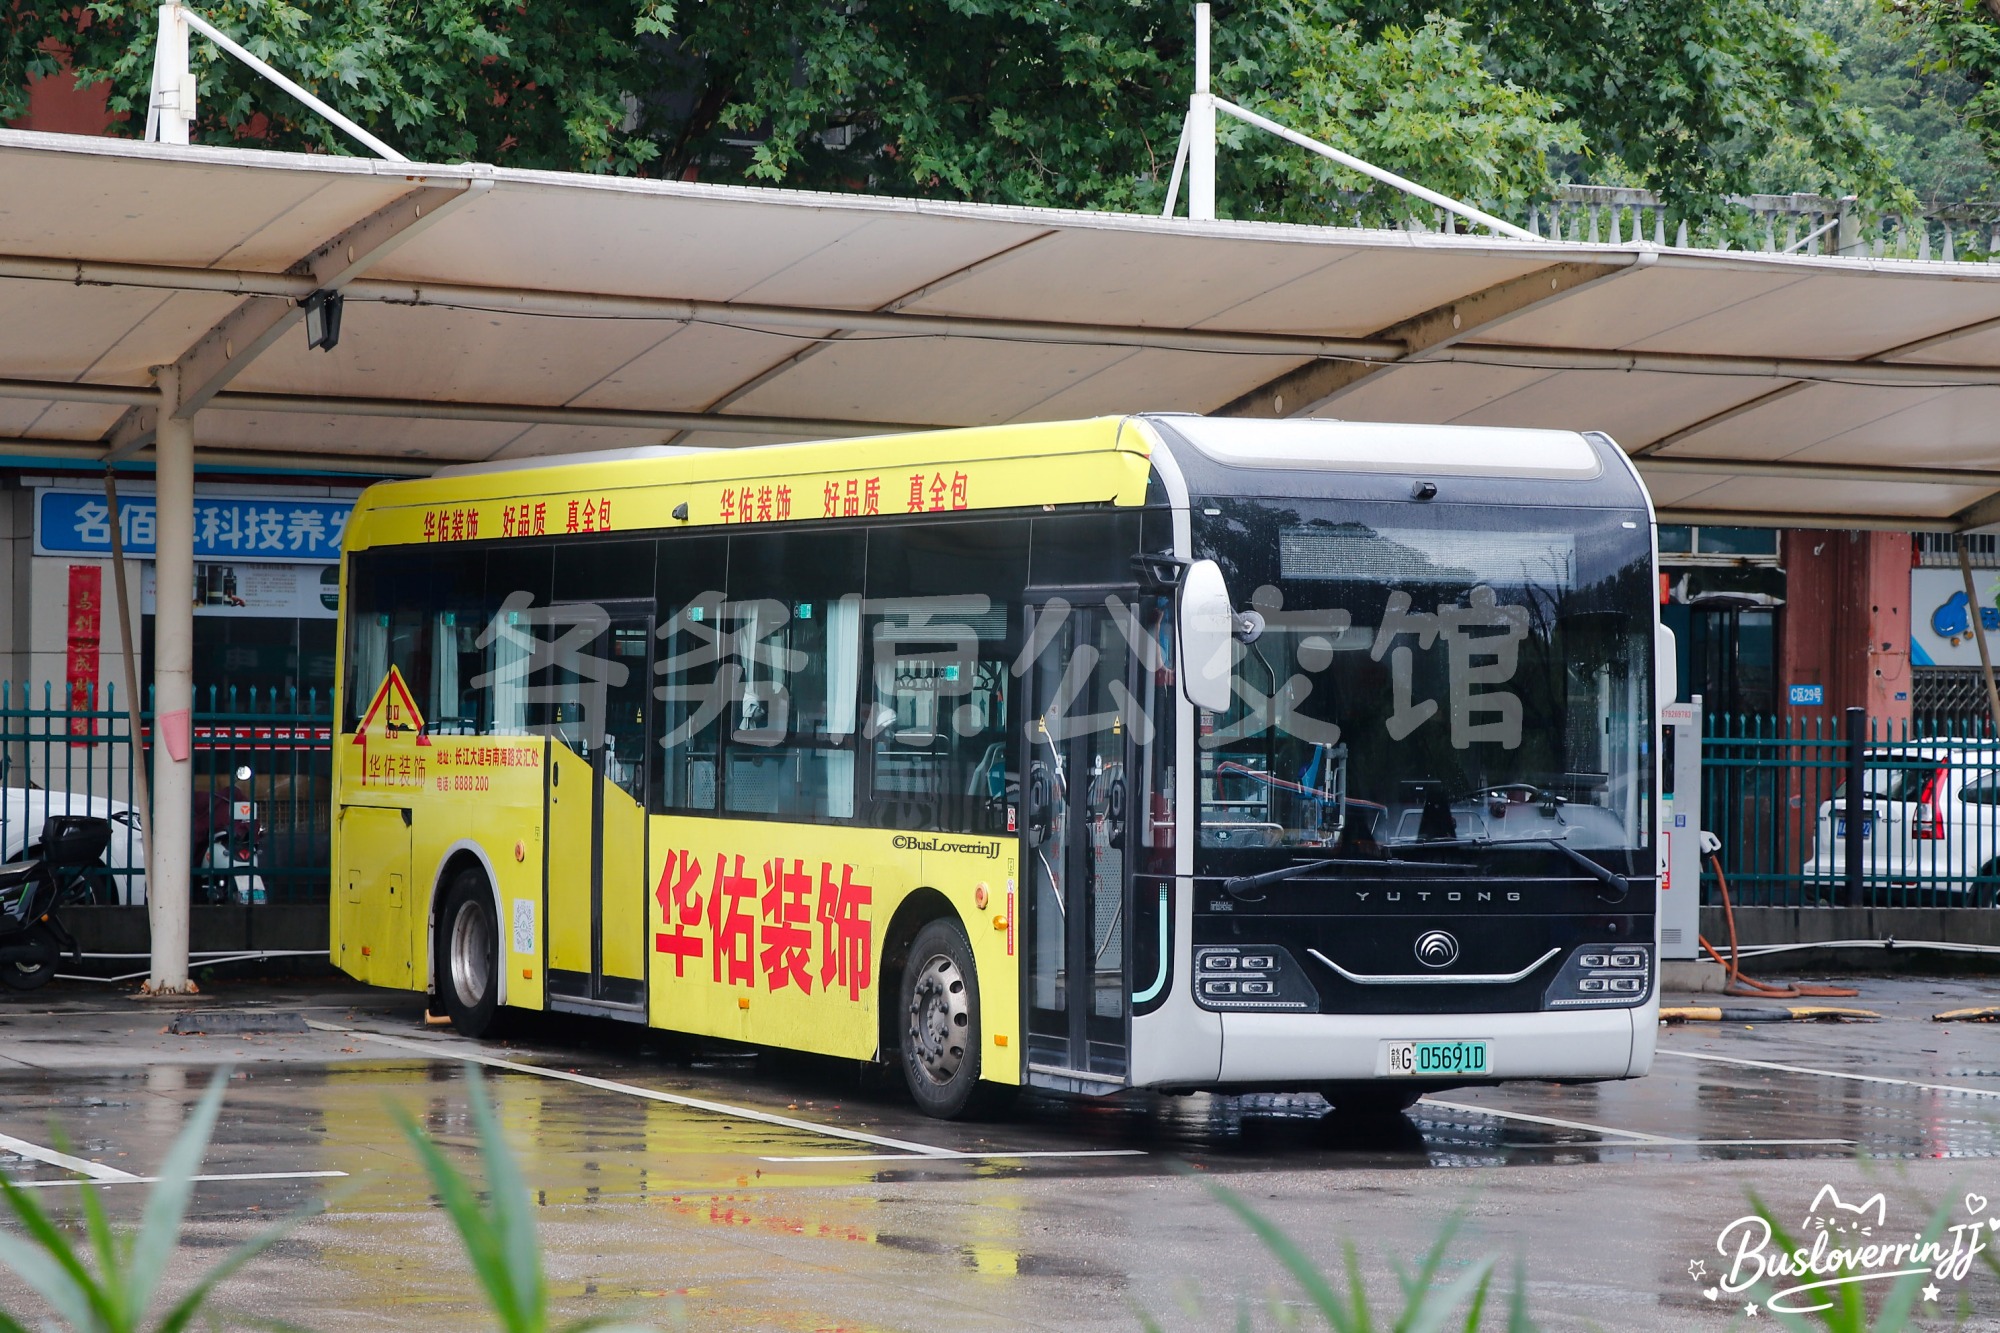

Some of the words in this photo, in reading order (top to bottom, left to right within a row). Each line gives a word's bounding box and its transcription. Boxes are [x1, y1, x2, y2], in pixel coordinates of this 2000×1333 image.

[720, 484, 792, 524] 华佑装饰
[823, 476, 881, 518] 好品质
[907, 470, 968, 513] 真全包
[423, 507, 479, 543] 华佑装饰
[502, 502, 547, 538] 好品质
[565, 496, 612, 534] 真全包
[1791, 687, 1822, 703] C区29号
[369, 754, 426, 788] 华佑装饰
[1355, 891, 1522, 902] YUTONG
[655, 848, 873, 1002] 华佑装饰
